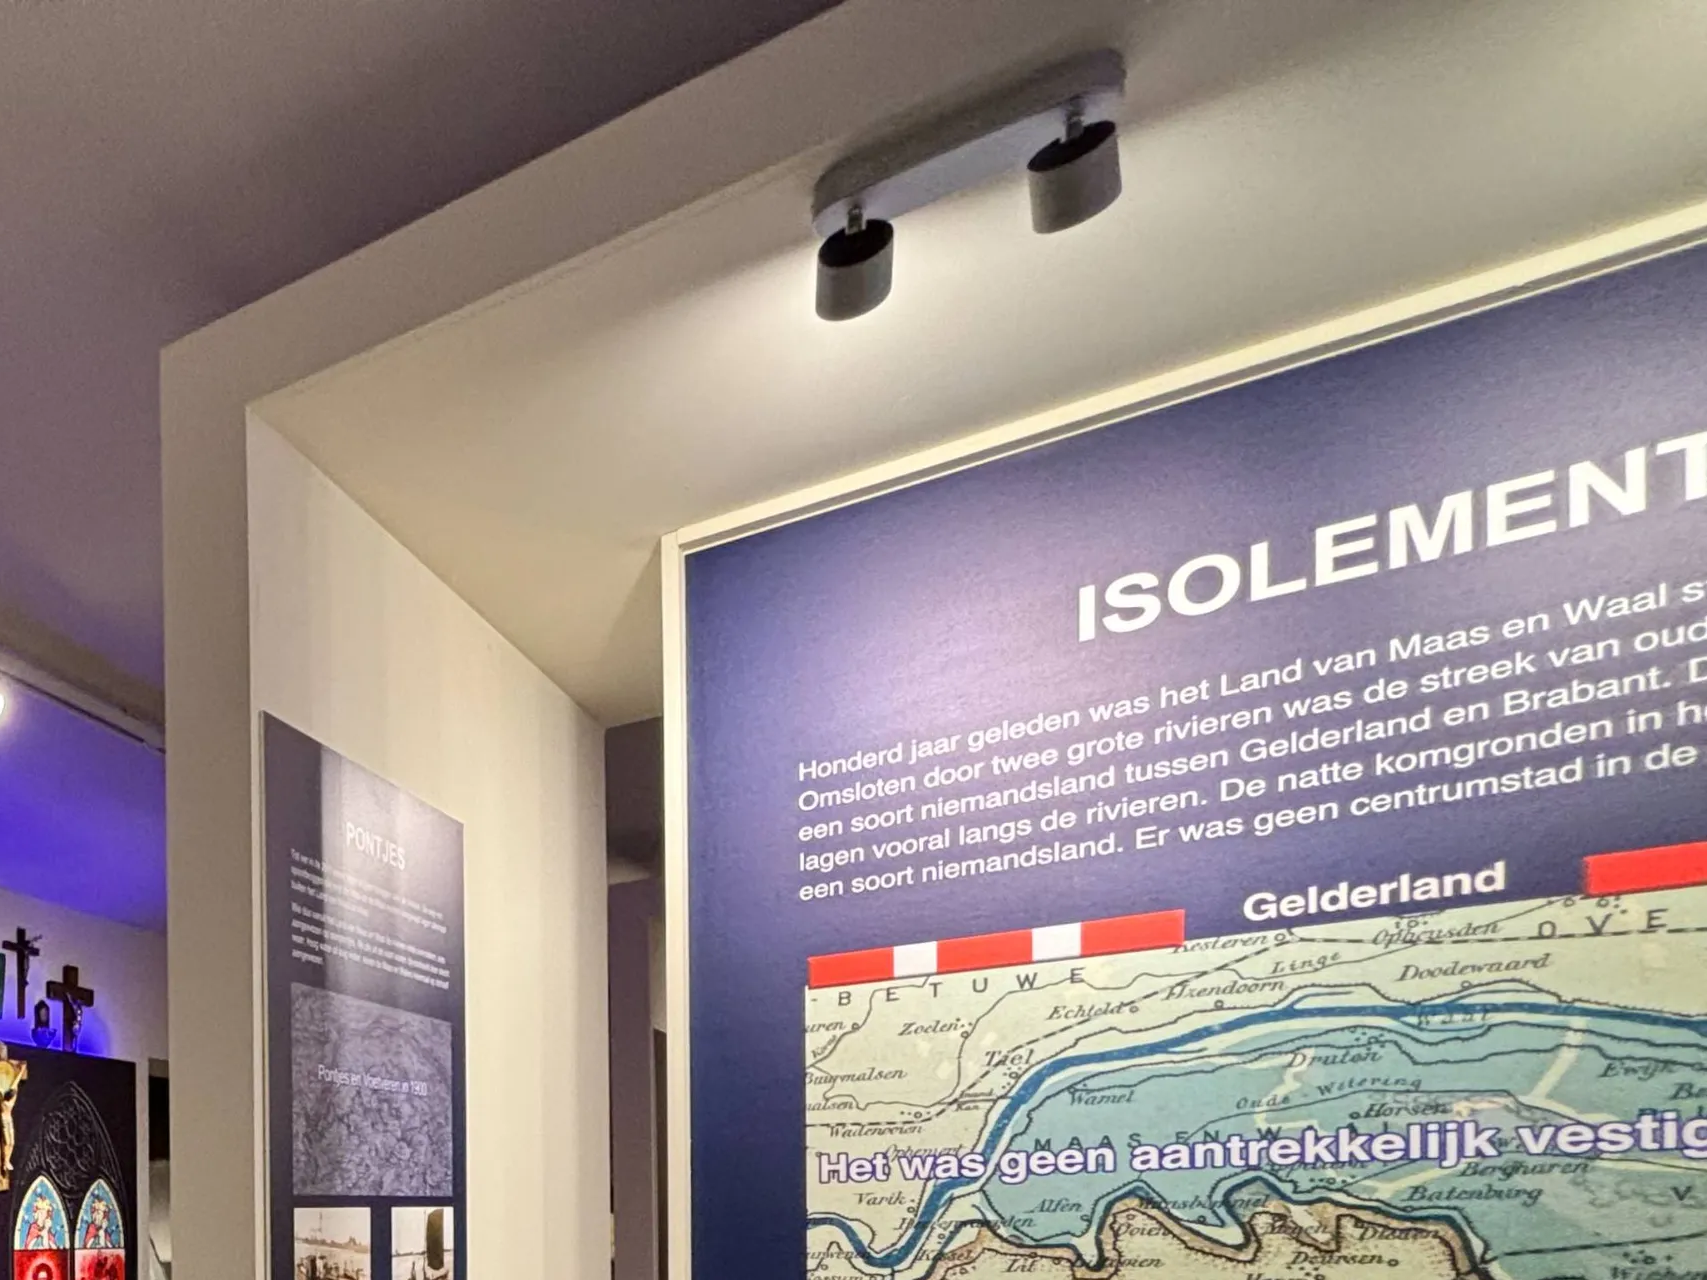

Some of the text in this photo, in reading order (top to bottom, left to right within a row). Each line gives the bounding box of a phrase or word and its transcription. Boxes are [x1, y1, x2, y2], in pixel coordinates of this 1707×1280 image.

[1078, 430, 1707, 643] ISOLEMENT
[798, 581, 1668, 782] Honderd jaar geleden was het Land van Maas en Waal
[798, 774, 916, 812] Omsloten
[923, 760, 985, 789] door
[990, 747, 1059, 776] twee
[1066, 730, 1145, 767] grote
[1154, 705, 1273, 746] rivieren
[1282, 689, 1353, 719] was
[1362, 677, 1409, 705] de
[1419, 650, 1537, 694] streek
[1547, 637, 1621, 669] van
[798, 665, 1672, 843] een soort niemandsland tussen Gelderland en Brabant.
[346, 821, 405, 871] PONTJES
[798, 742, 1699, 902] een soort niemandsland. Er was geen centrumstad in de
[799, 707, 1663, 874] lagen vooral langs de rivieren. De natte komgronden in
[1243, 860, 1507, 922] Gelderland
[817, 1152, 890, 1184] Het
[897, 1153, 987, 1183] was
[999, 1144, 1116, 1185] geen
[1131, 1119, 1501, 1171] aantrekkelijk
